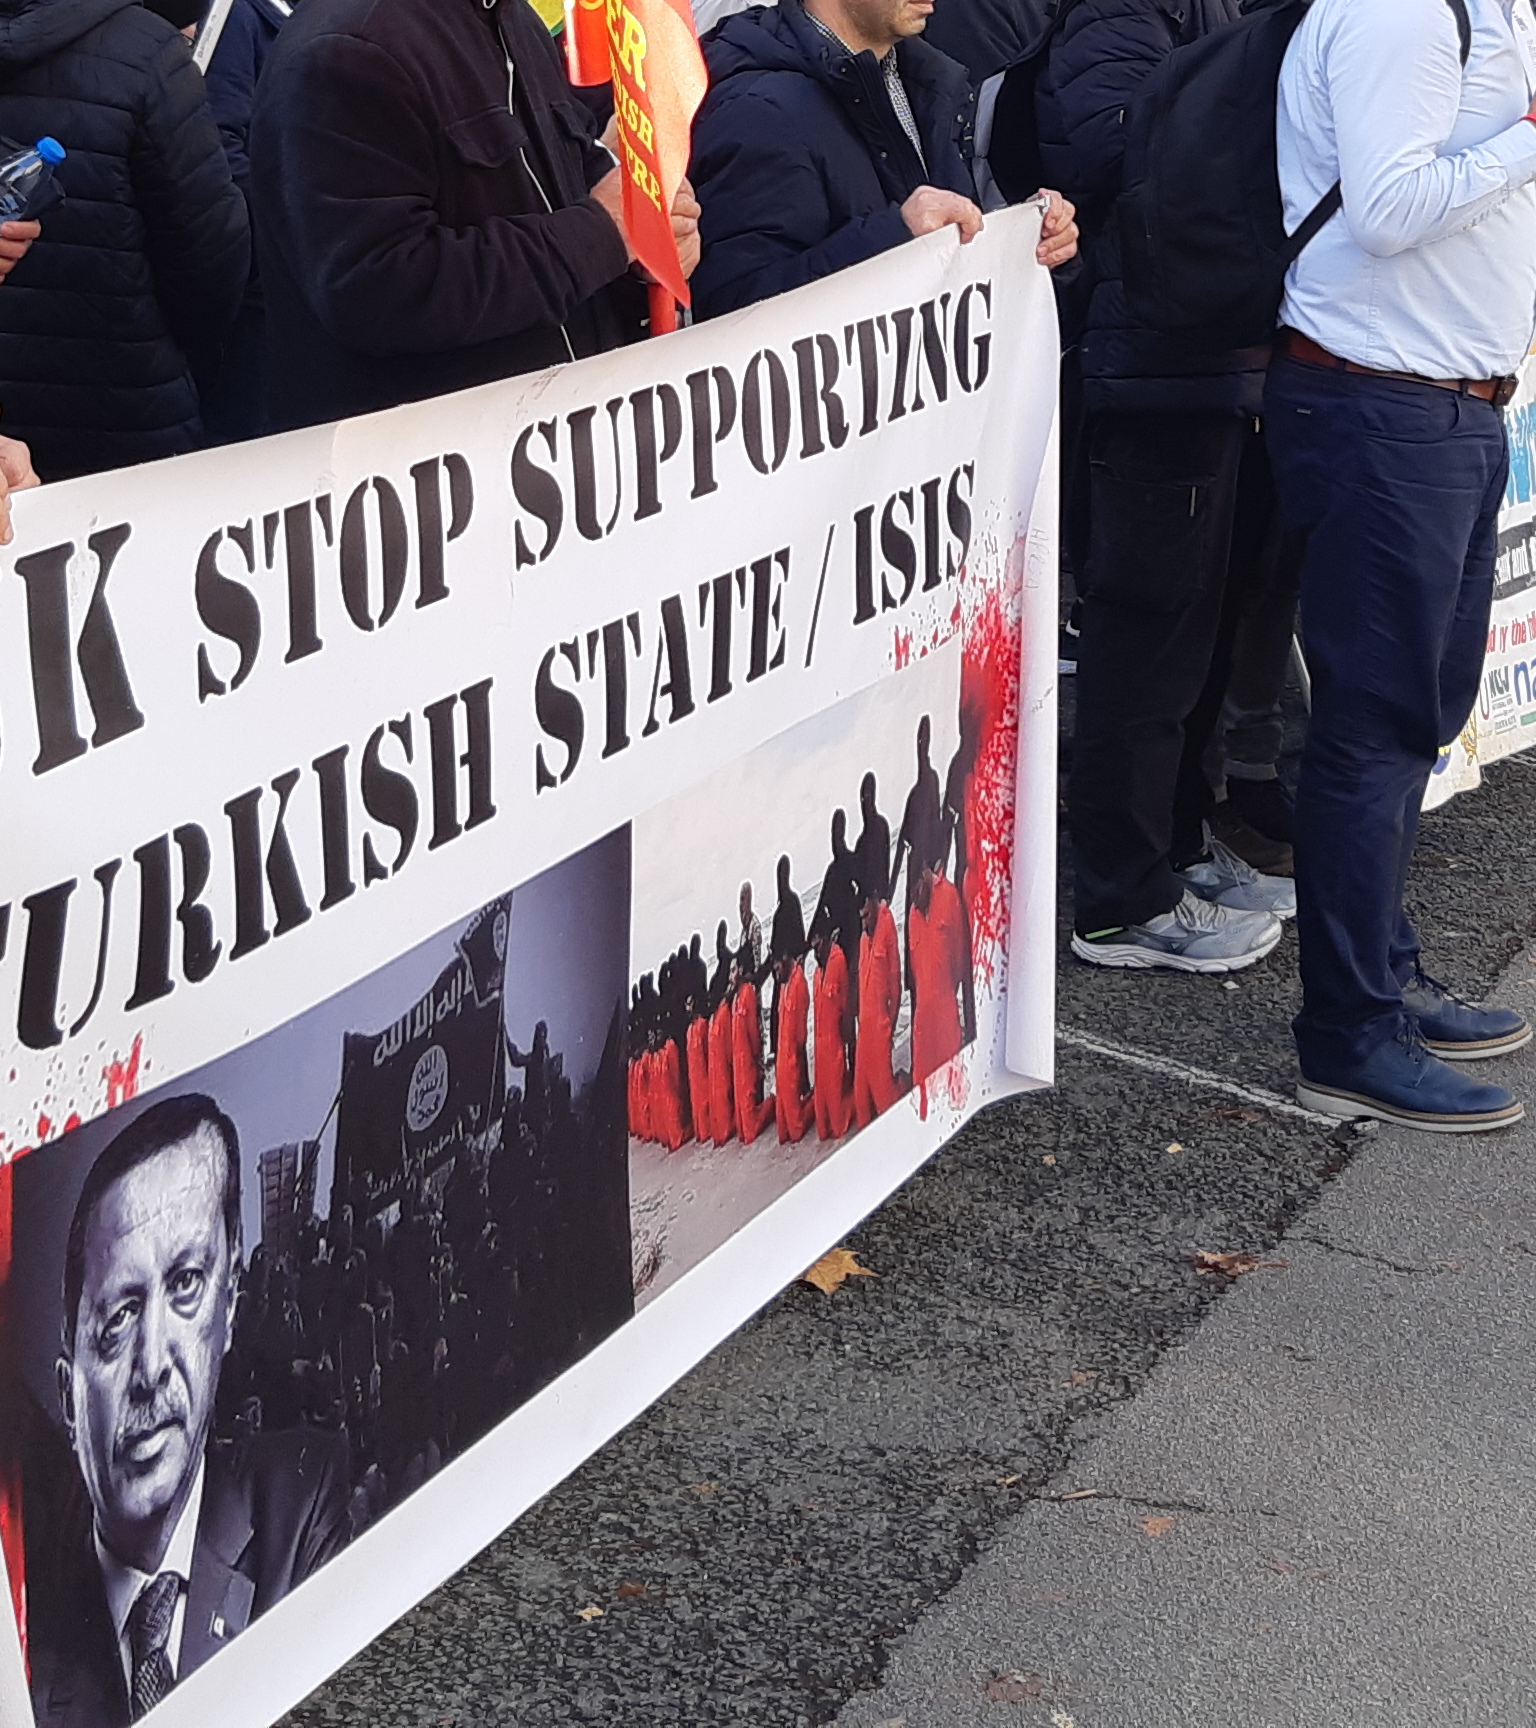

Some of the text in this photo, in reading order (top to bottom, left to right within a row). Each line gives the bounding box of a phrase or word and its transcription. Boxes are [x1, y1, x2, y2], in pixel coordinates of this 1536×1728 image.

[195, 452, 472, 703] STOP
[511, 279, 992, 571] SUPPORTING
[534, 545, 791, 795] STATE
[853, 459, 975, 625] ISIS
